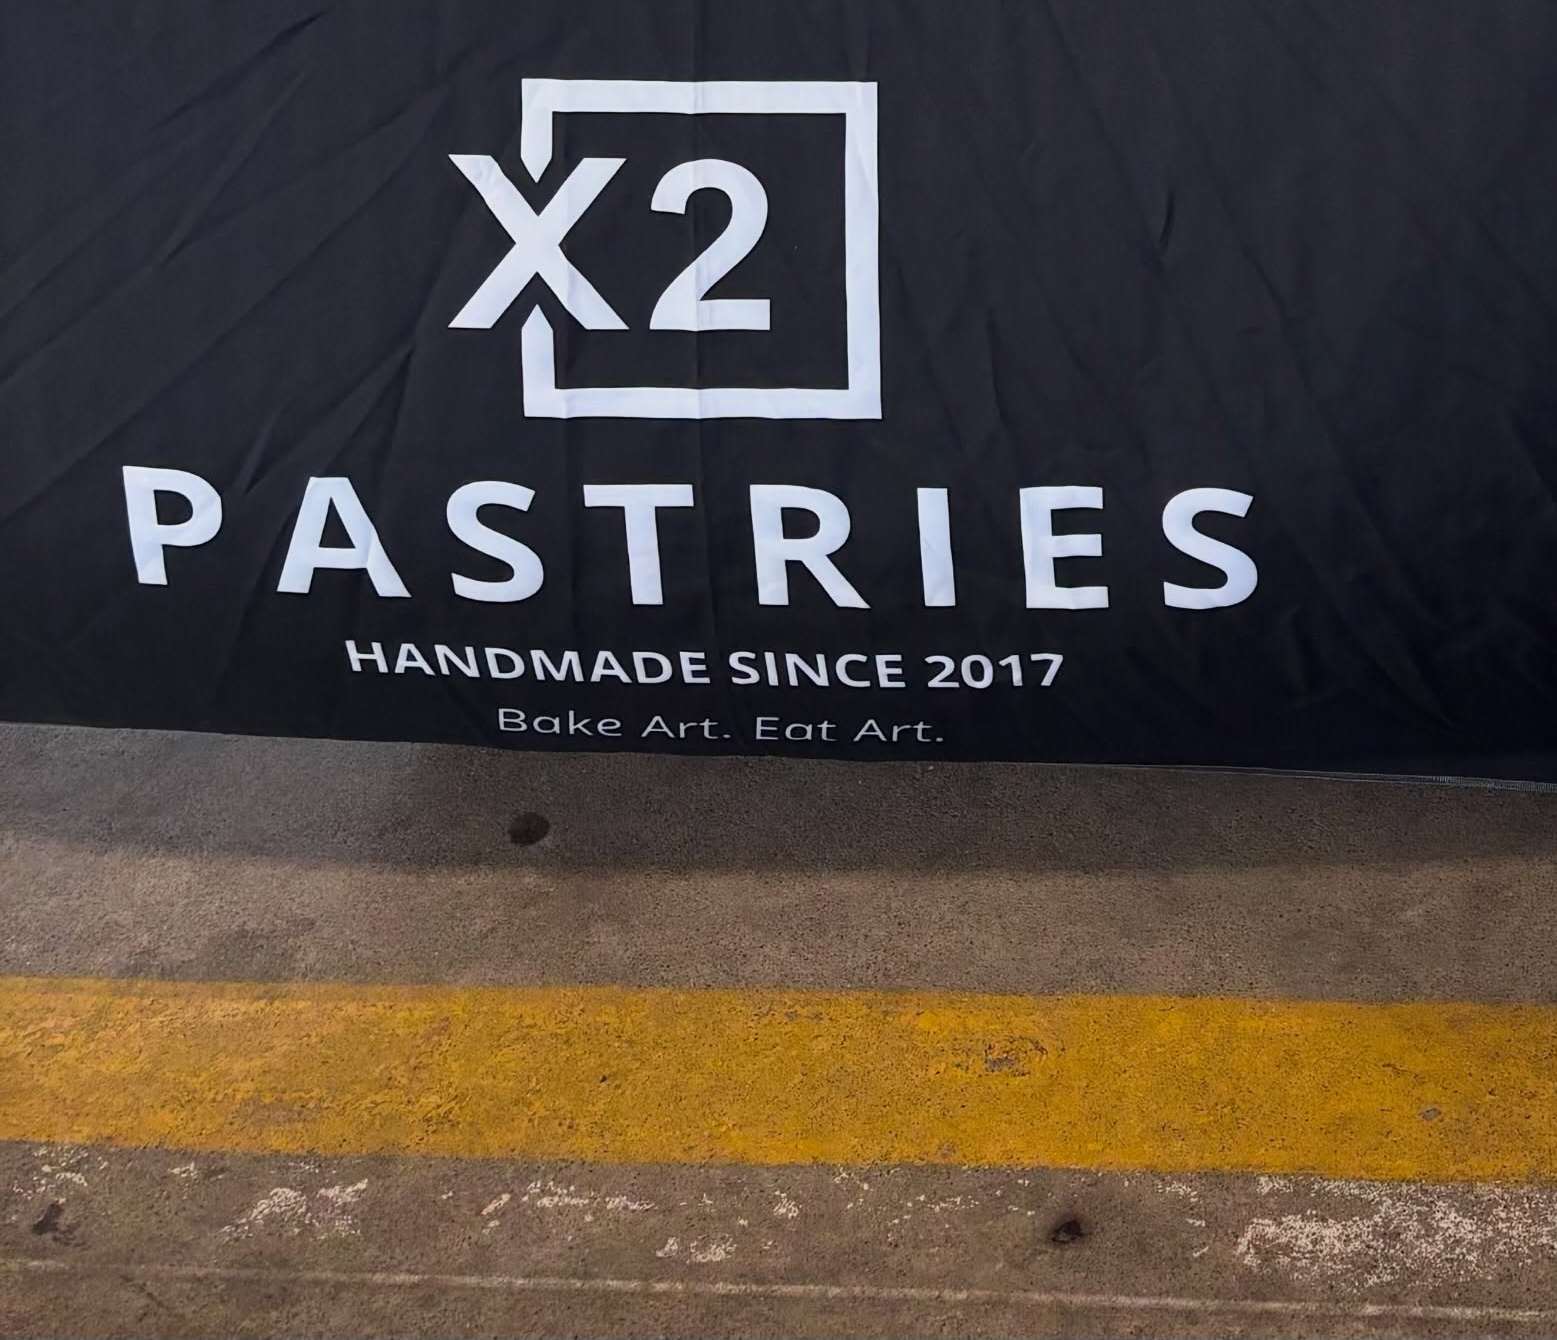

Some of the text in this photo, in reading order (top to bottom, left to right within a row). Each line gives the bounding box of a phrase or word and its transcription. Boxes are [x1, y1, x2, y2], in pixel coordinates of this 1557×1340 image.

[448, 154, 772, 331] X2
[122, 465, 1258, 609] PASTRIES
[345, 639, 1065, 690] HANDMADE SINCE 2017
[497, 707, 945, 743] Bake Art. Eat Art.
